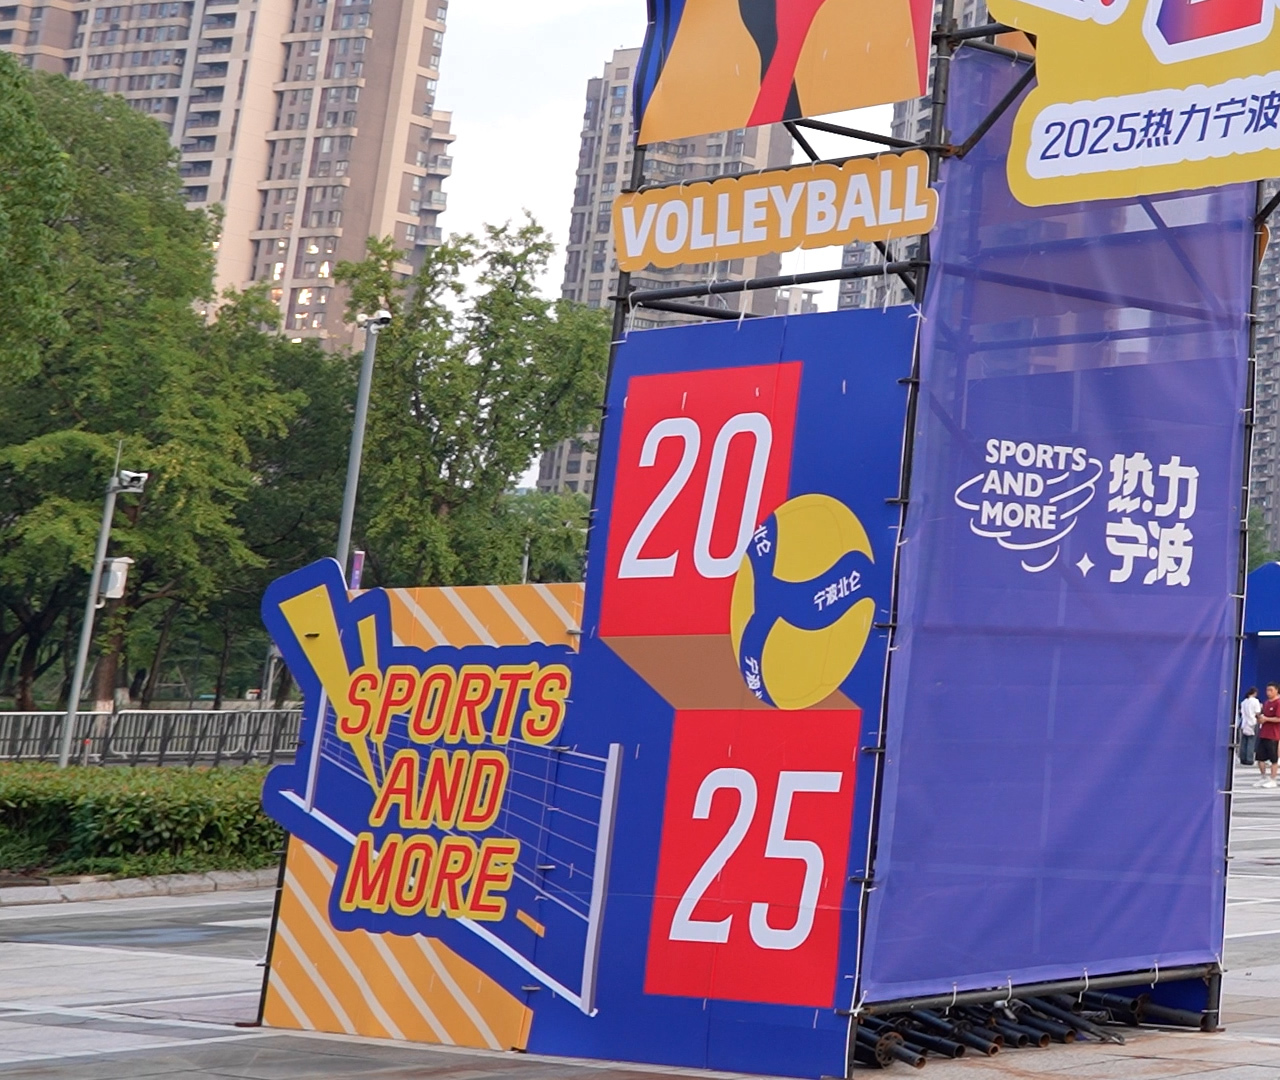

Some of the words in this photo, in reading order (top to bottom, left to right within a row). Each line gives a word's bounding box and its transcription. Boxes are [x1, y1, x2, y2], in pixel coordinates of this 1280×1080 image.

[621, 165, 930, 258] VOLLEYBALL
[981, 469, 1044, 498] AND
[984, 438, 1087, 472] SPORTS
[1108, 452, 1199, 519] 热力
[617, 411, 774, 580] 20
[980, 499, 1057, 530] MORE
[1106, 517, 1193, 587] 宁波
[813, 570, 862, 611] 宁波北仑
[339, 670, 569, 738] SPORTS
[373, 755, 505, 824] AND
[343, 839, 516, 913] MORE
[668, 766, 844, 953] 25
